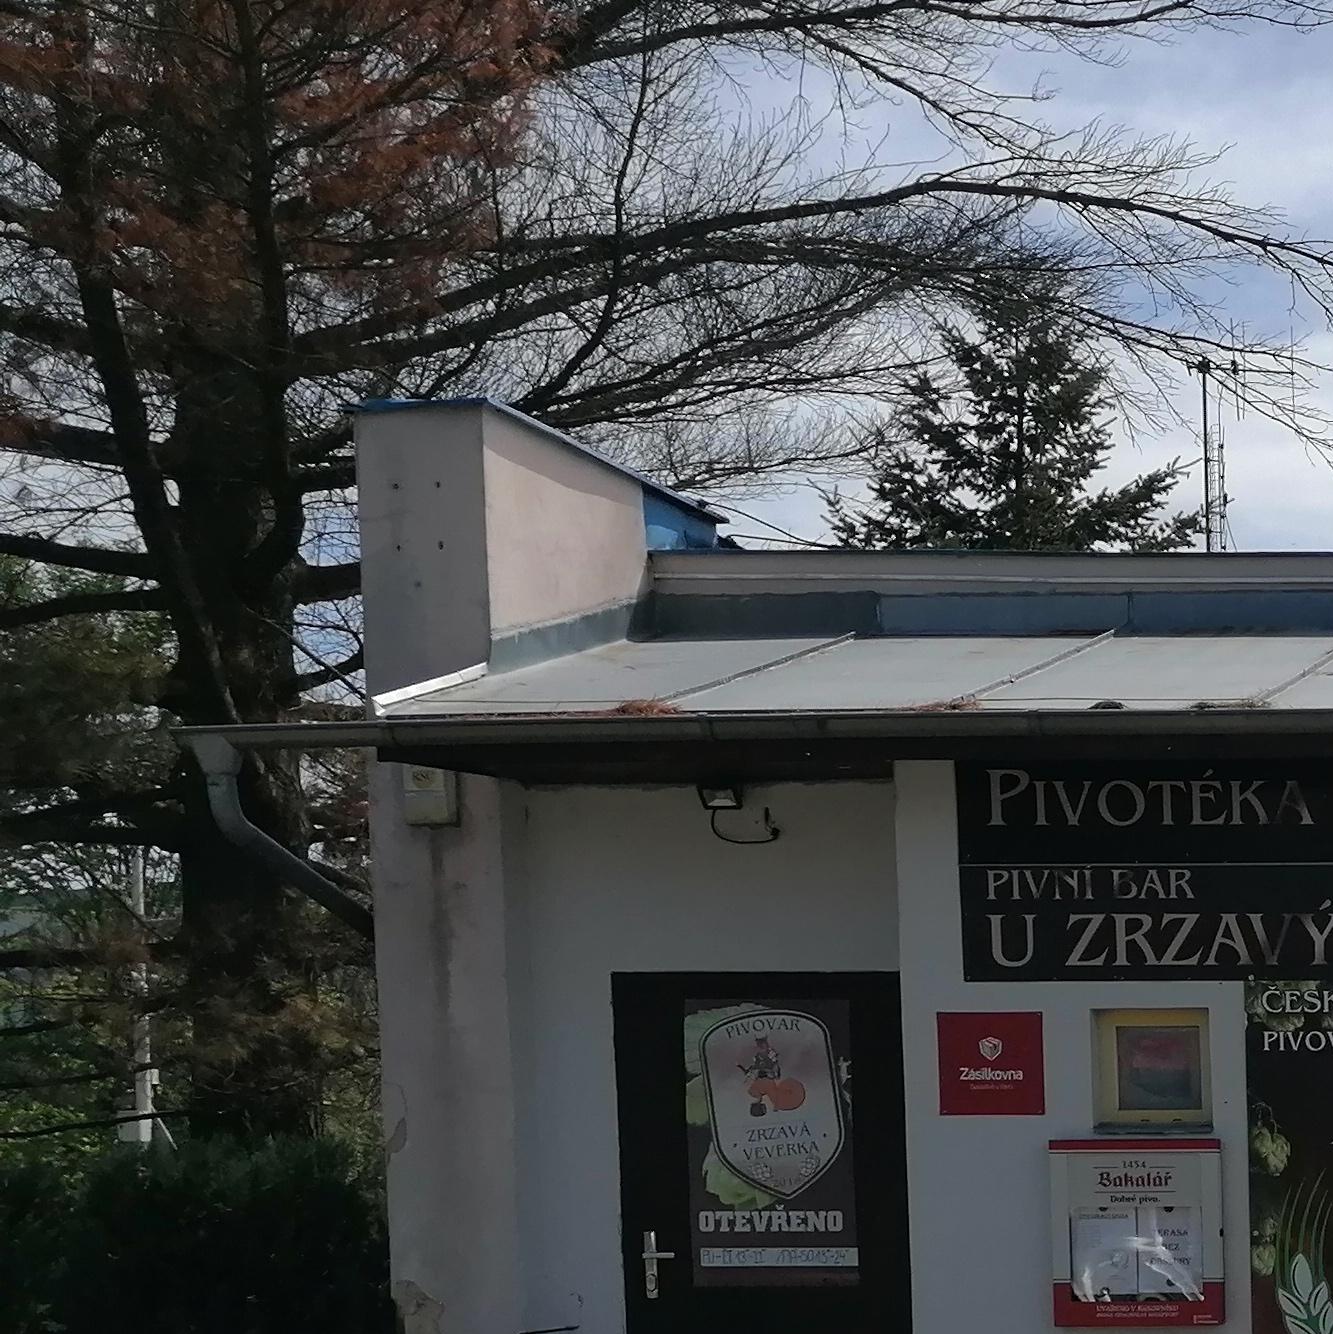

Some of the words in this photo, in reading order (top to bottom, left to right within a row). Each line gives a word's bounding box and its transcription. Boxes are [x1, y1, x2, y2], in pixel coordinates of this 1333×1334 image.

[986, 864, 1094, 901] PIVNÍ
[1112, 868, 1195, 899] BAR
[986, 913, 1036, 968] U
[724, 1018, 801, 1040] PIVOVAR
[959, 1067, 1023, 1080] Zásilkovna
[746, 1121, 812, 1142] ZRZAVÁ
[742, 1140, 821, 1161] VEVERKA
[1121, 1160, 1147, 1168] 1454
[1098, 1171, 1173, 1188] Bakalář
[699, 1204, 843, 1232] OTEVŘENO
